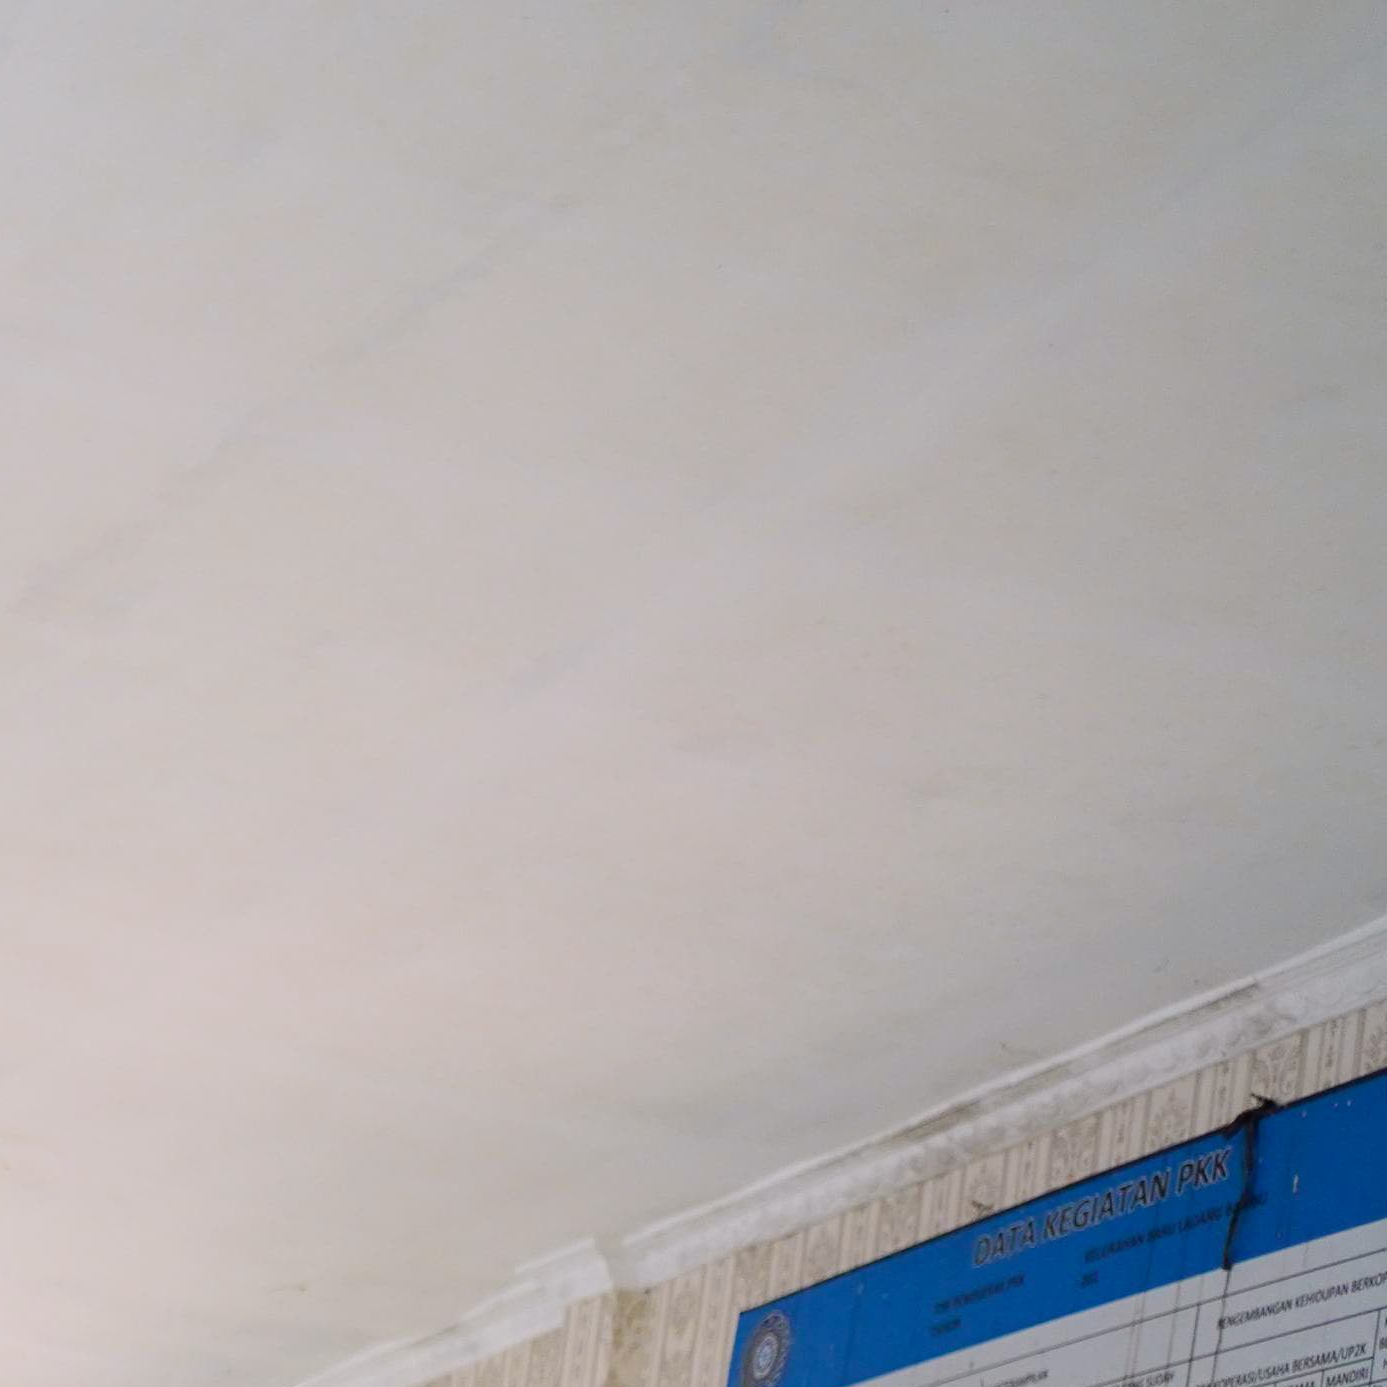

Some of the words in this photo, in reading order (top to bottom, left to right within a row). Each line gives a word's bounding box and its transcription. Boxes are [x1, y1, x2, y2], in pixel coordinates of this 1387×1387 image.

[971, 1218, 1037, 1269] DATA
[1042, 1165, 1172, 1245] KEGIATAN
[1175, 1145, 1233, 1196] PKK
[1294, 1283, 1349, 1308] KEHIDUPAN
[1291, 1343, 1367, 1373] BERSAMA/UP2K
[1326, 1368, 1369, 1387] MANDIRI
